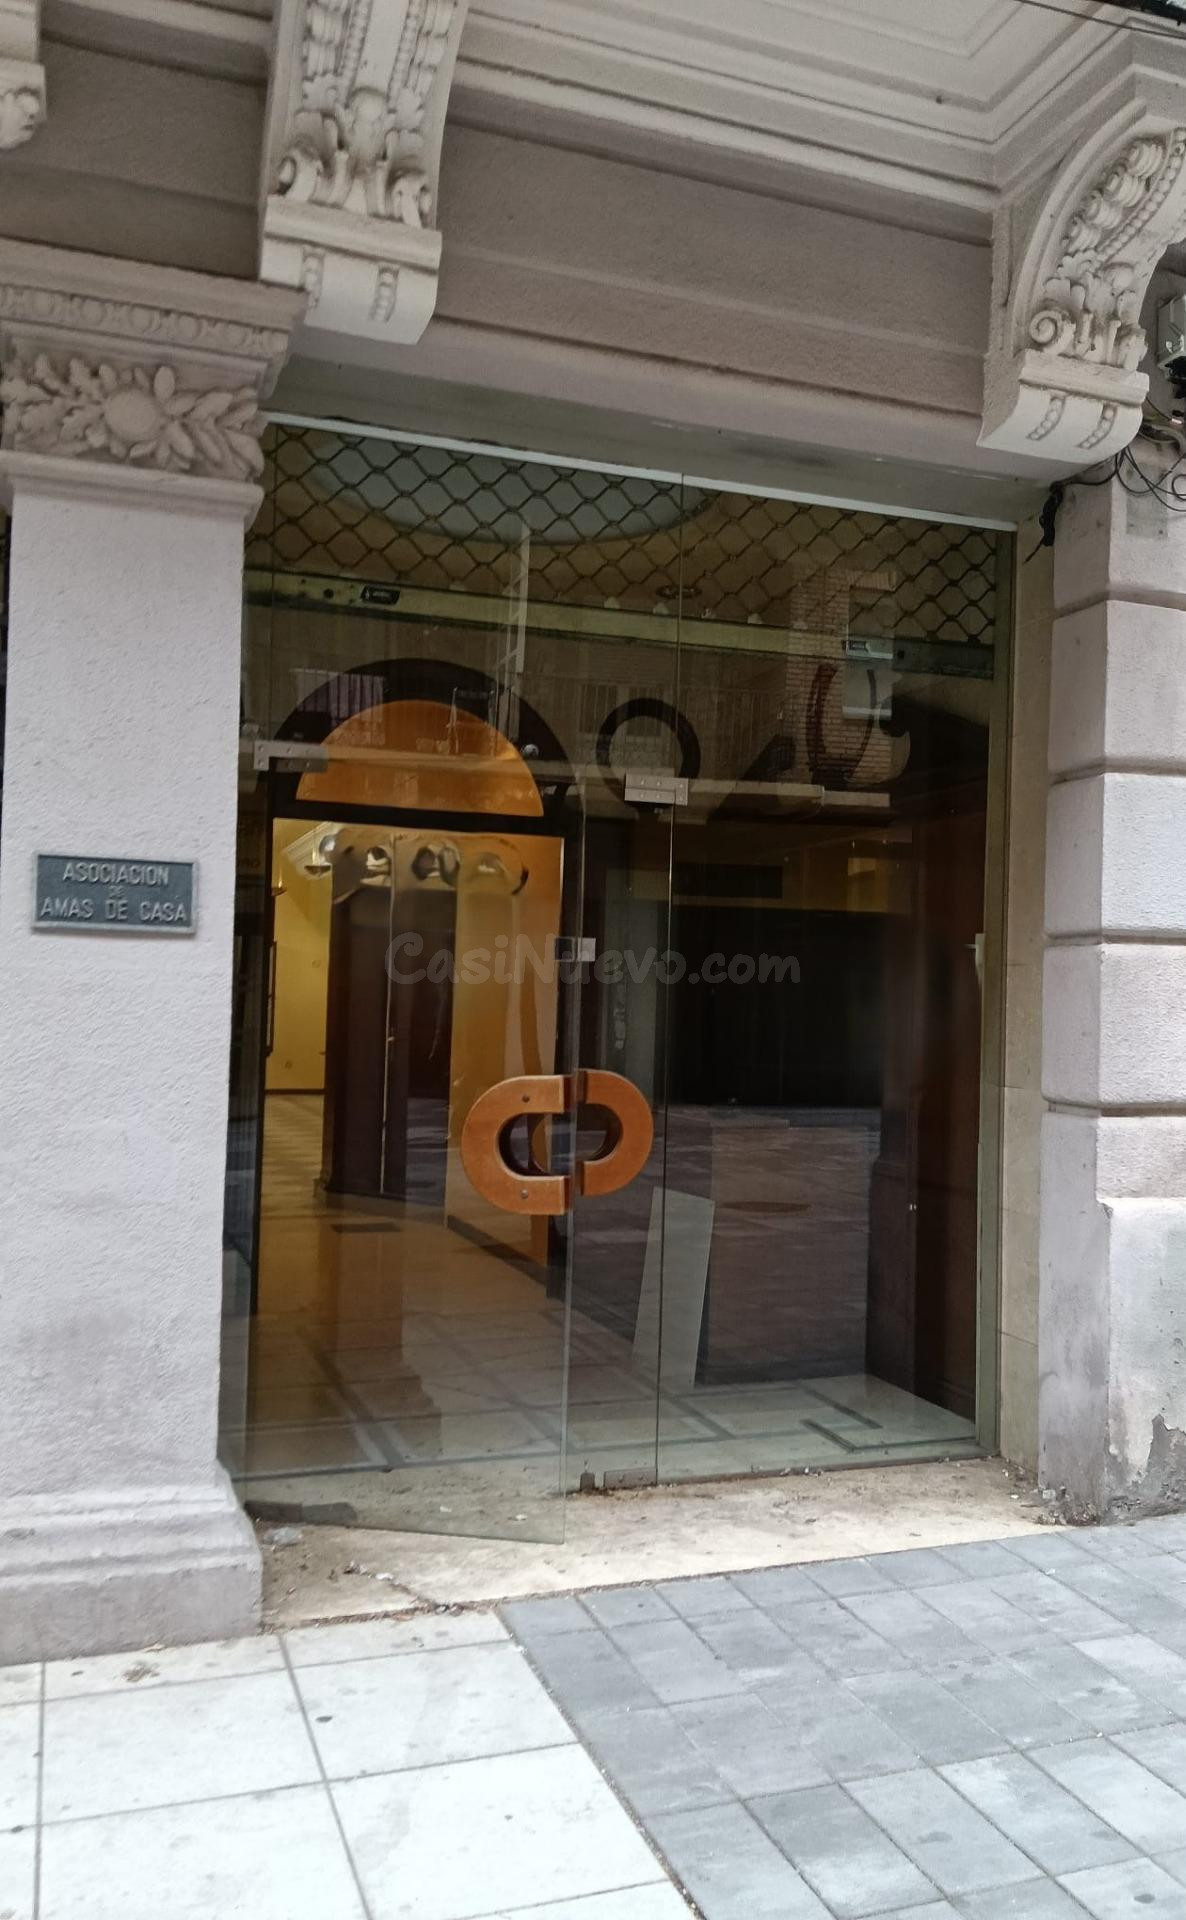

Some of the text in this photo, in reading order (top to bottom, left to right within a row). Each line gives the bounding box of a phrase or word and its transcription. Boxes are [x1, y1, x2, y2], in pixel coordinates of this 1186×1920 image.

[62, 862, 169, 887] ASOCIACION
[40, 897, 188, 922] AMAS DE CASA
